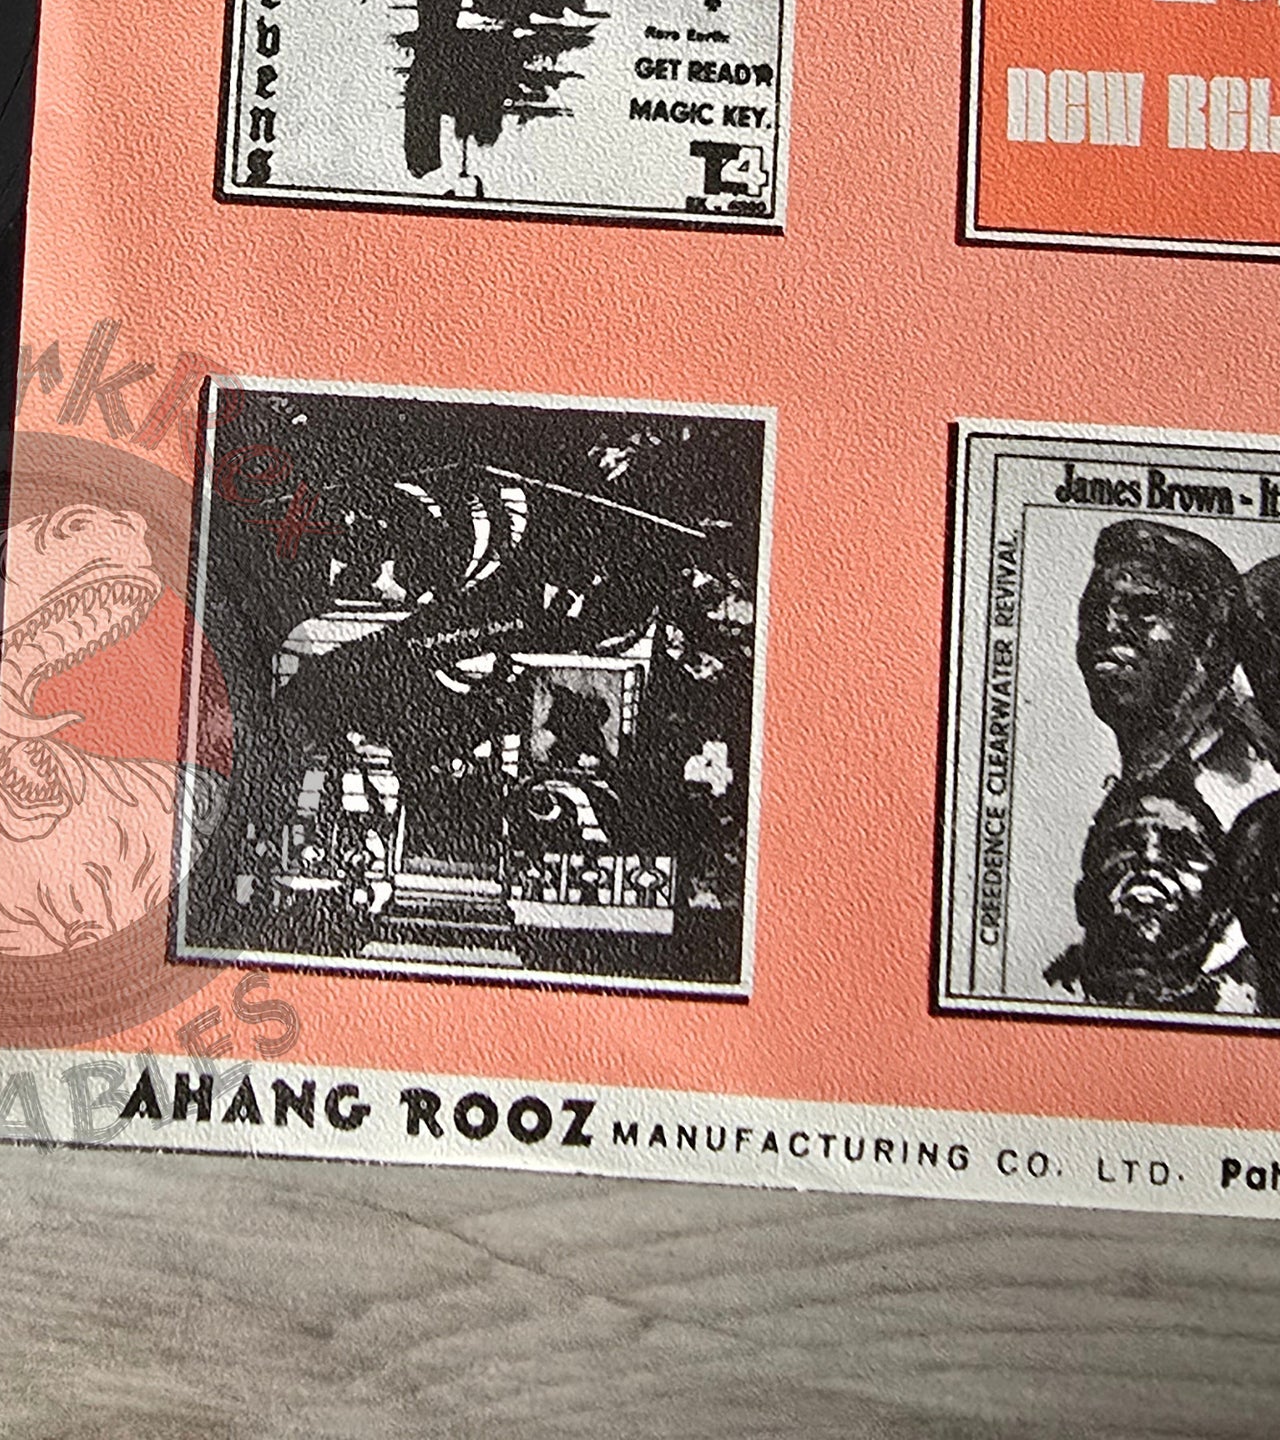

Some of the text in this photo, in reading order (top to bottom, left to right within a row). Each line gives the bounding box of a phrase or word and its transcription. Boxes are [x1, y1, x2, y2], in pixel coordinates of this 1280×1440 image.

[630, 98, 713, 125] MAGIC
[635, 58, 681, 83] GET
[1055, 464, 1141, 507] James
[1147, 469, 1234, 515] Brown
[986, 638, 1014, 796] CLEARWATER
[980, 807, 1007, 947] CREEDENCE
[120, 1066, 372, 1131] AHANG
[400, 1087, 597, 1147] ROOZ
[612, 1121, 970, 1172] MANUFACTURING
[997, 1149, 1062, 1178] CO.
[1098, 1156, 1184, 1186] LTD.
